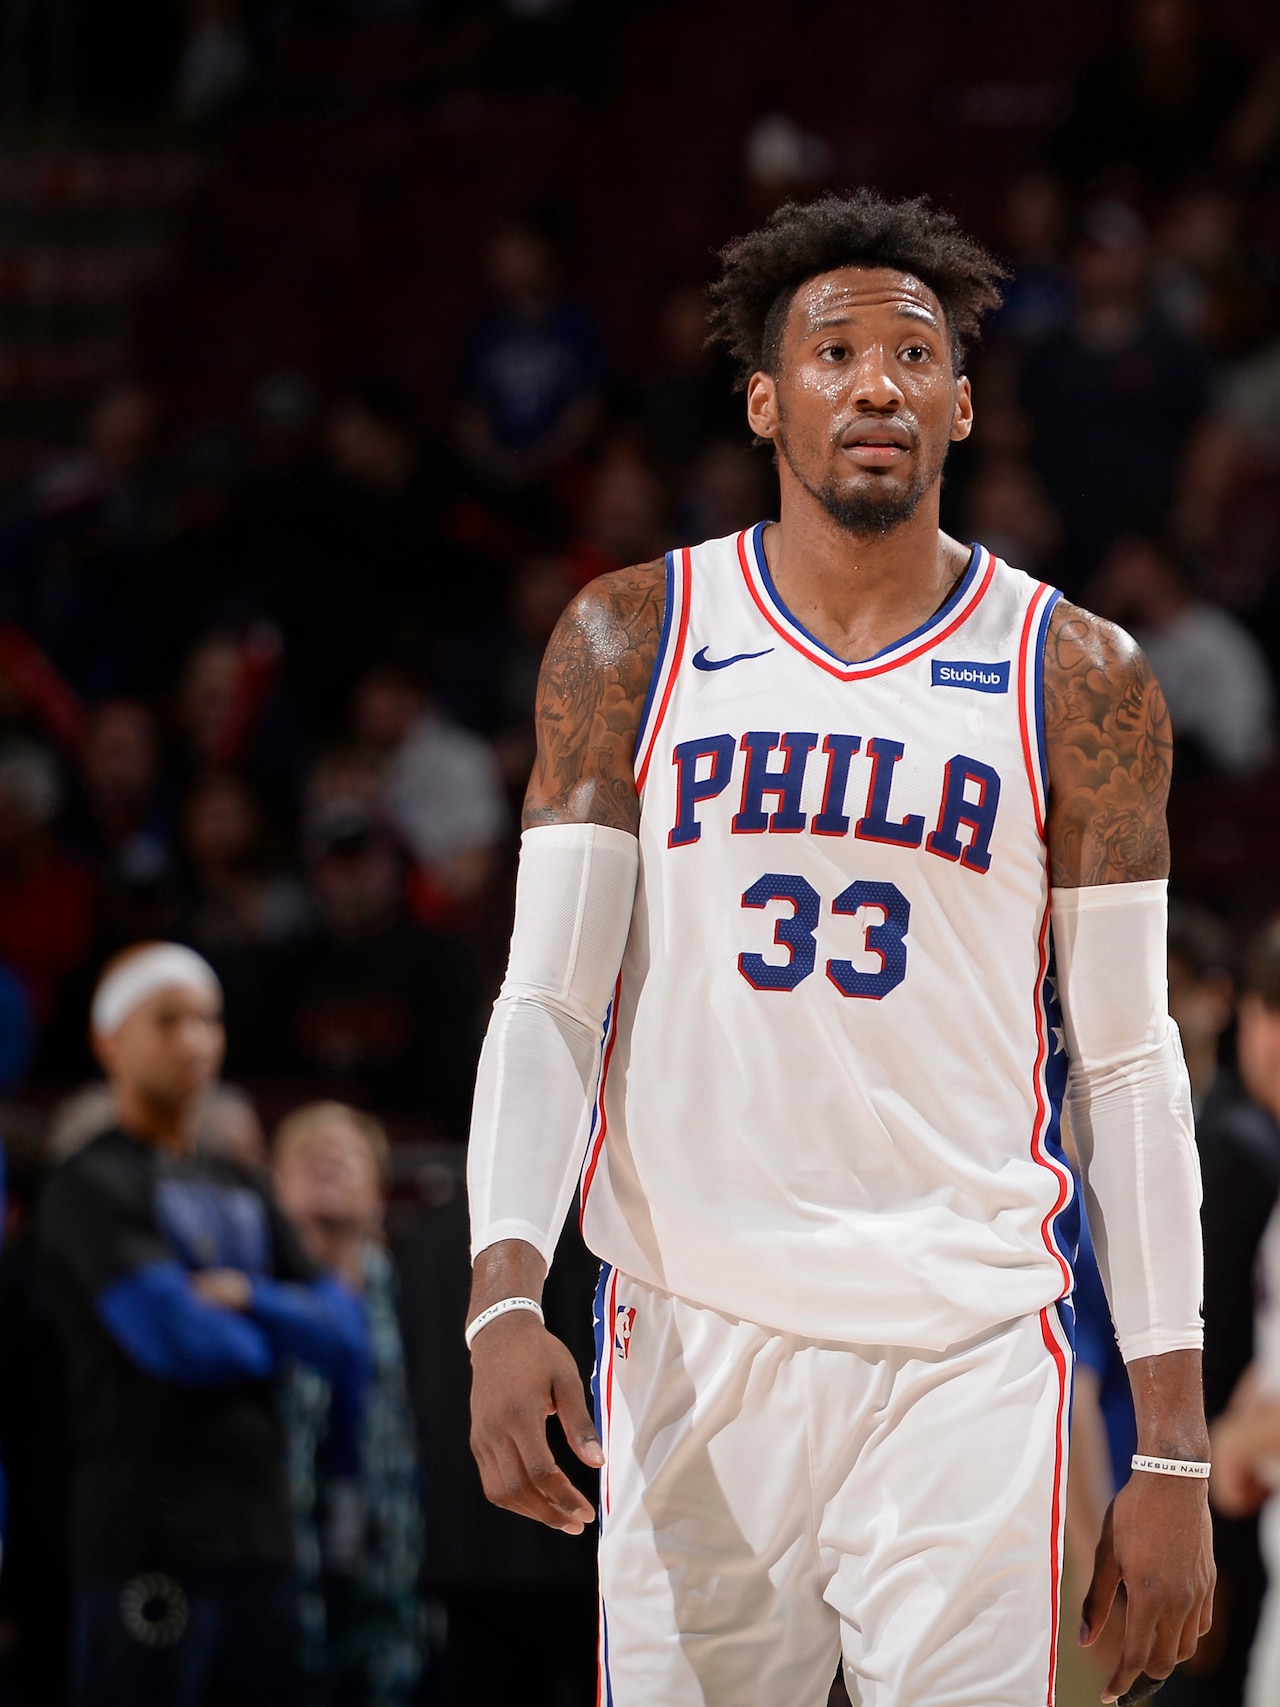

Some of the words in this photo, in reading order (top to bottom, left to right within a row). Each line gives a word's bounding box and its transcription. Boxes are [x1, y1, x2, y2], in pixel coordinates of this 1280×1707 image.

[939, 667, 1001, 685] StubHub
[667, 731, 1001, 875] PHILA
[737, 873, 912, 1001] 33
[477, 1306, 499, 1324] PLAY
[1140, 1460, 1177, 1471] JESUS
[1180, 1465, 1204, 1474] NAME
